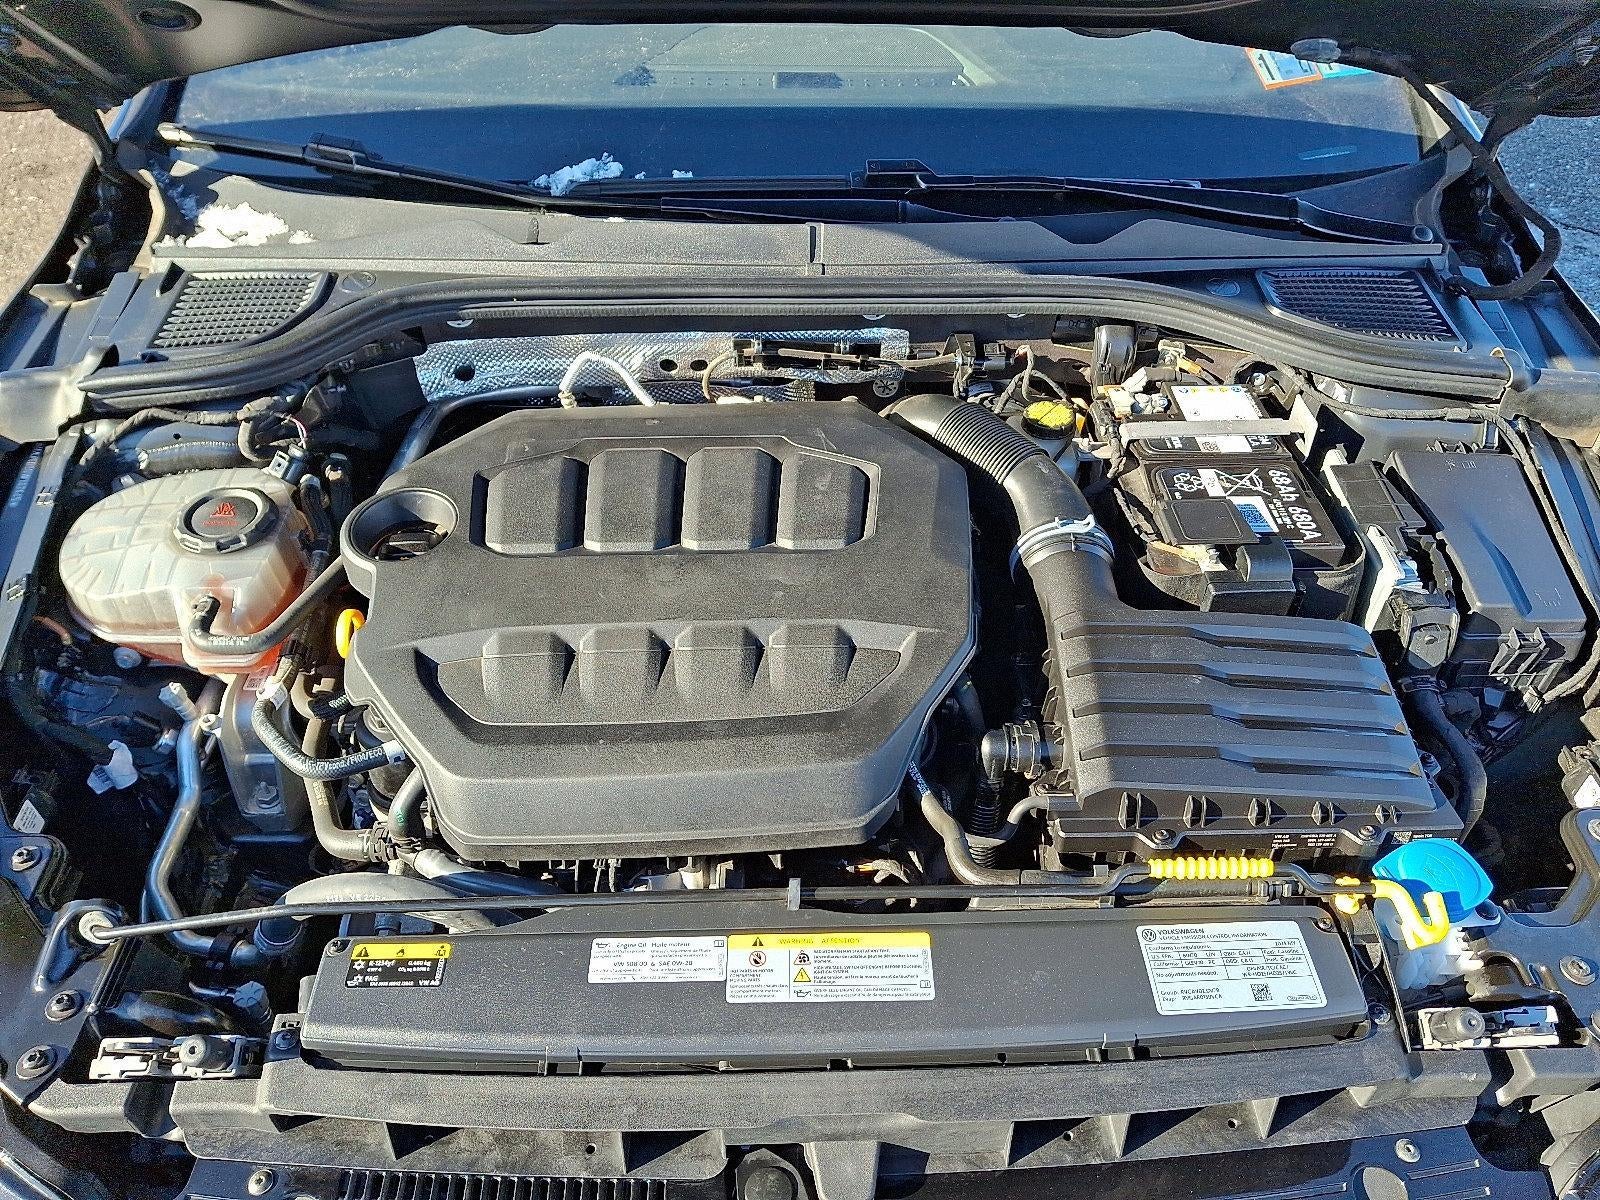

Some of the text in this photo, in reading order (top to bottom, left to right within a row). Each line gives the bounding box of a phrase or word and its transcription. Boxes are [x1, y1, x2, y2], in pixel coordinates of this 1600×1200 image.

[1268, 469, 1300, 501] 68Ah
[1288, 506, 1322, 541] 680A
[1157, 928, 1205, 936] VOLKSWAGEN
